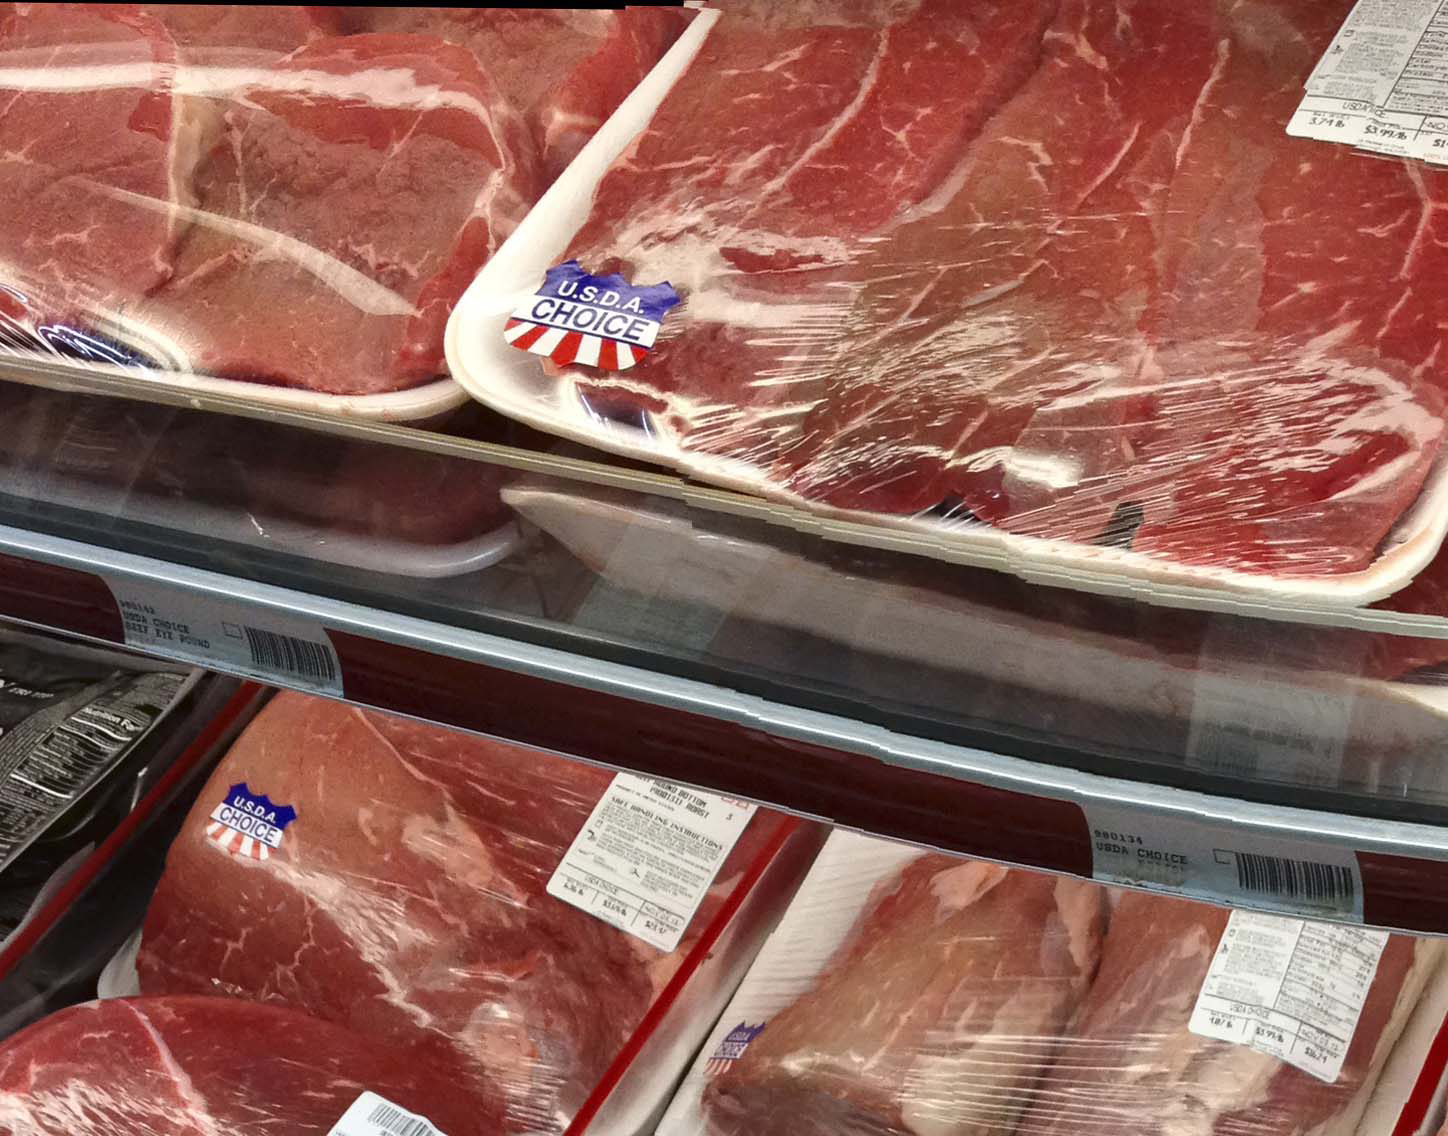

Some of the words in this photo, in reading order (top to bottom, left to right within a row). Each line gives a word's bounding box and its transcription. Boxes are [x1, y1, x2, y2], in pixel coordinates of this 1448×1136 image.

[558, 281, 644, 314] U.S.D.A.
[531, 299, 650, 341] CHOICE
[220, 806, 278, 842] CHOICE
[1096, 842, 1129, 857] USDA
[1137, 848, 1188, 865] CHOICE
